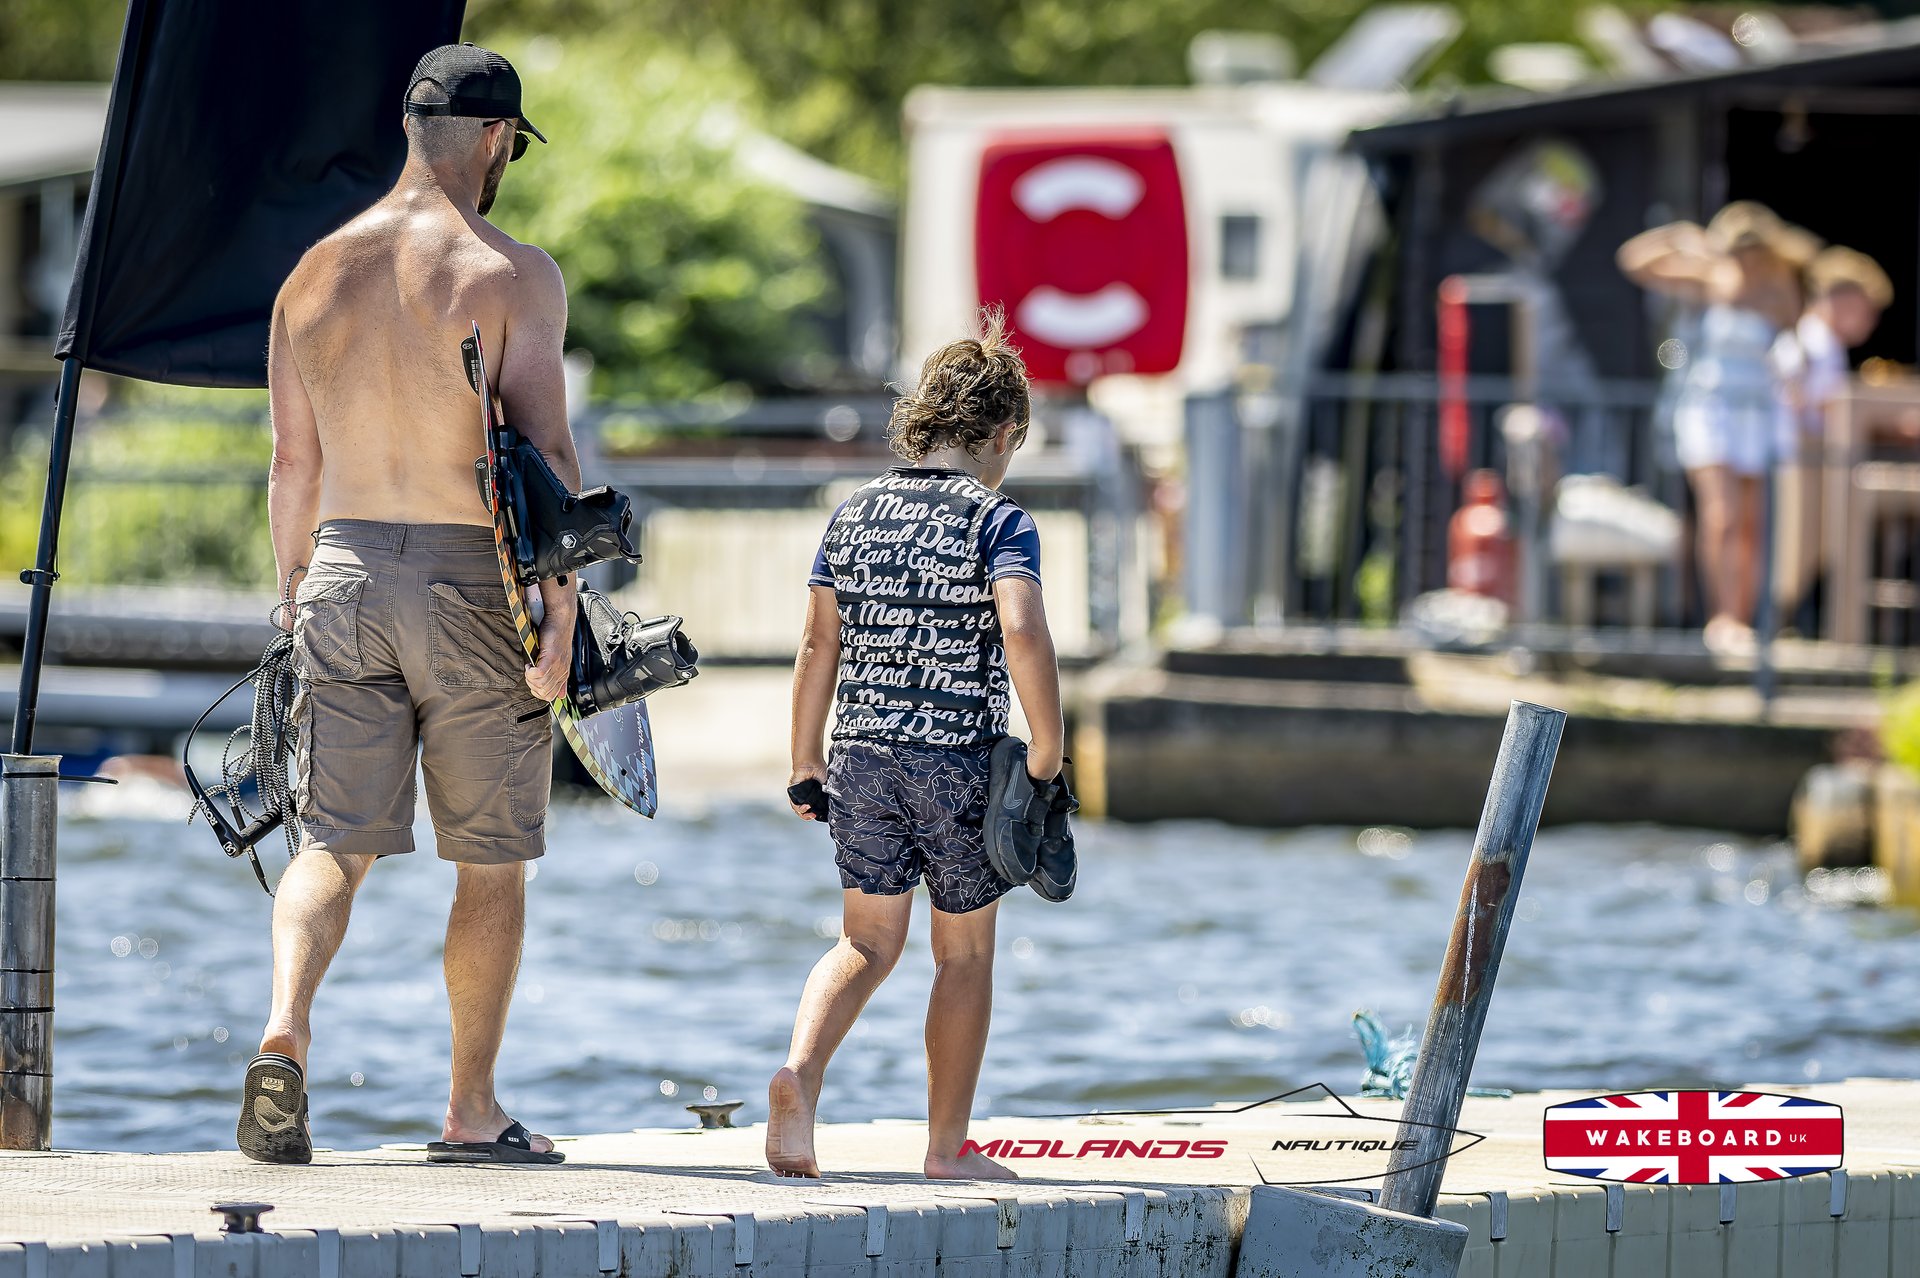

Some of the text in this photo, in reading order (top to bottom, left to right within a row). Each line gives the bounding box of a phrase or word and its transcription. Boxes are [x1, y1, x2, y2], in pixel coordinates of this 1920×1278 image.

[939, 476, 987, 504] Me
[871, 494, 930, 521] Men
[850, 523, 919, 546] Catcall
[854, 544, 907, 566] Can't
[908, 546, 976, 580] Catcall
[853, 563, 910, 598] Dead
[917, 570, 980, 603] Men
[859, 600, 916, 626] Men
[918, 608, 976, 631] Can't
[847, 626, 907, 648] Catcall
[909, 626, 980, 656] Dead
[856, 646, 904, 663] Can't
[902, 711, 978, 745] Dead
[199, 794, 218, 826] RONIX
